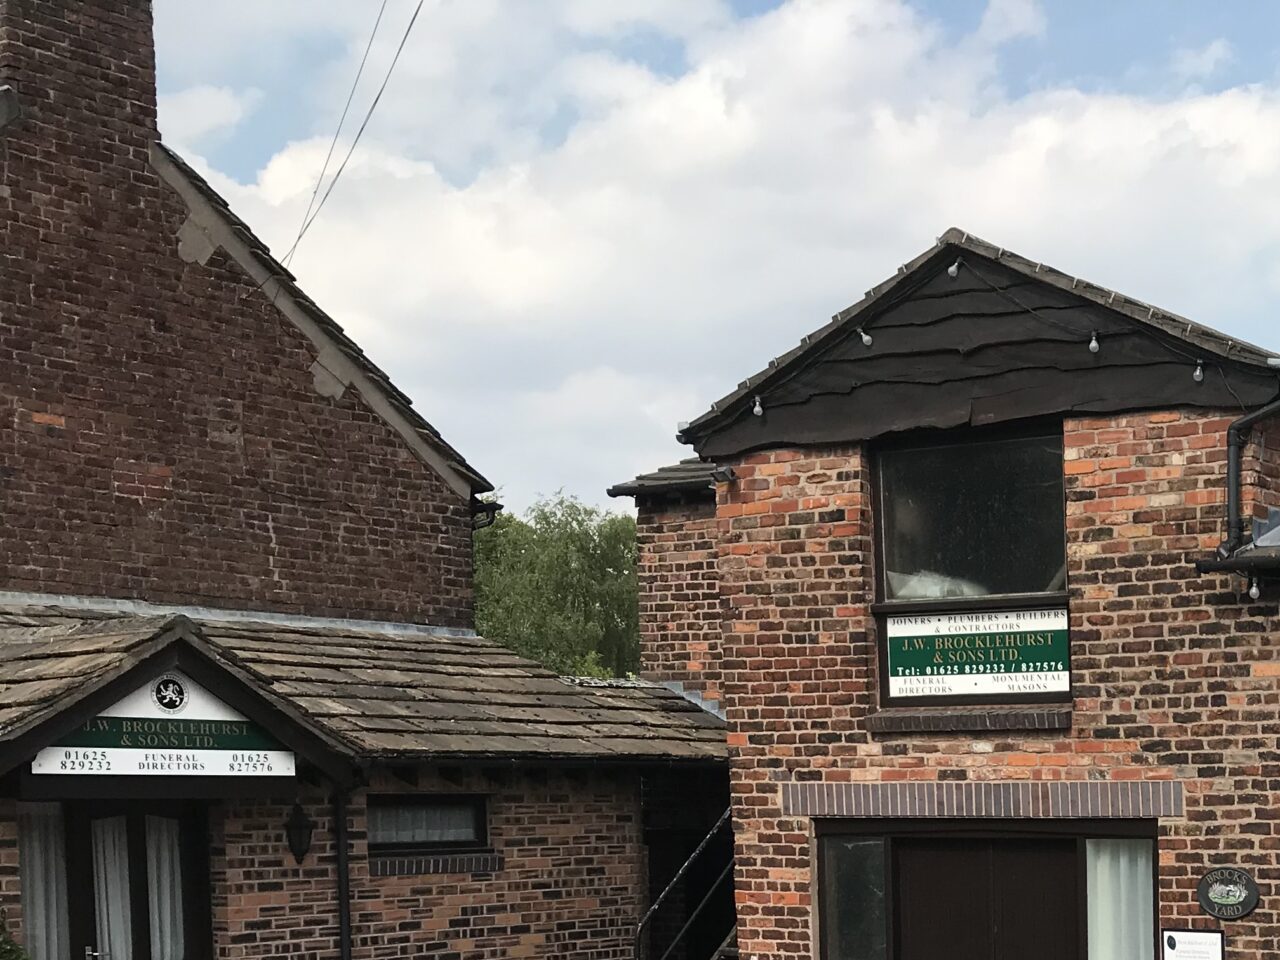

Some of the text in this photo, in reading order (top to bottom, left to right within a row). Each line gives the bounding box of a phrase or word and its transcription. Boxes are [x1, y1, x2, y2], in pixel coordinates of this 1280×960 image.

[892, 610, 1066, 626] JOINERS PLUMBERS BUILDERS
[948, 623, 1021, 632] CONTRACTORS
[902, 632, 1054, 652] J.W. BROCKLEHURST
[933, 648, 1023, 664] & SONS LTD.
[896, 666, 921, 676] Tel:
[926, 664, 959, 675] 01625
[964, 663, 1006, 674] 829232
[1021, 661, 1064, 672] 827576
[903, 677, 948, 686] FUNERAL
[992, 674, 1063, 683] MONUMENTAL
[898, 686, 953, 694] DIRECTORS
[1007, 683, 1048, 692] MASONS
[83, 720, 249, 736] J.W. BROCKLEHURST
[120, 734, 218, 748] & SONS LTD.
[64, 750, 108, 760] 01625
[144, 753, 198, 762] FUNERAL
[232, 753, 270, 763] 01625
[60, 760, 112, 771] 829232
[138, 762, 206, 770] DIRECTORS
[228, 762, 273, 772] 827576
[1206, 869, 1248, 884] BROCKS
[1213, 904, 1242, 916] YARD
